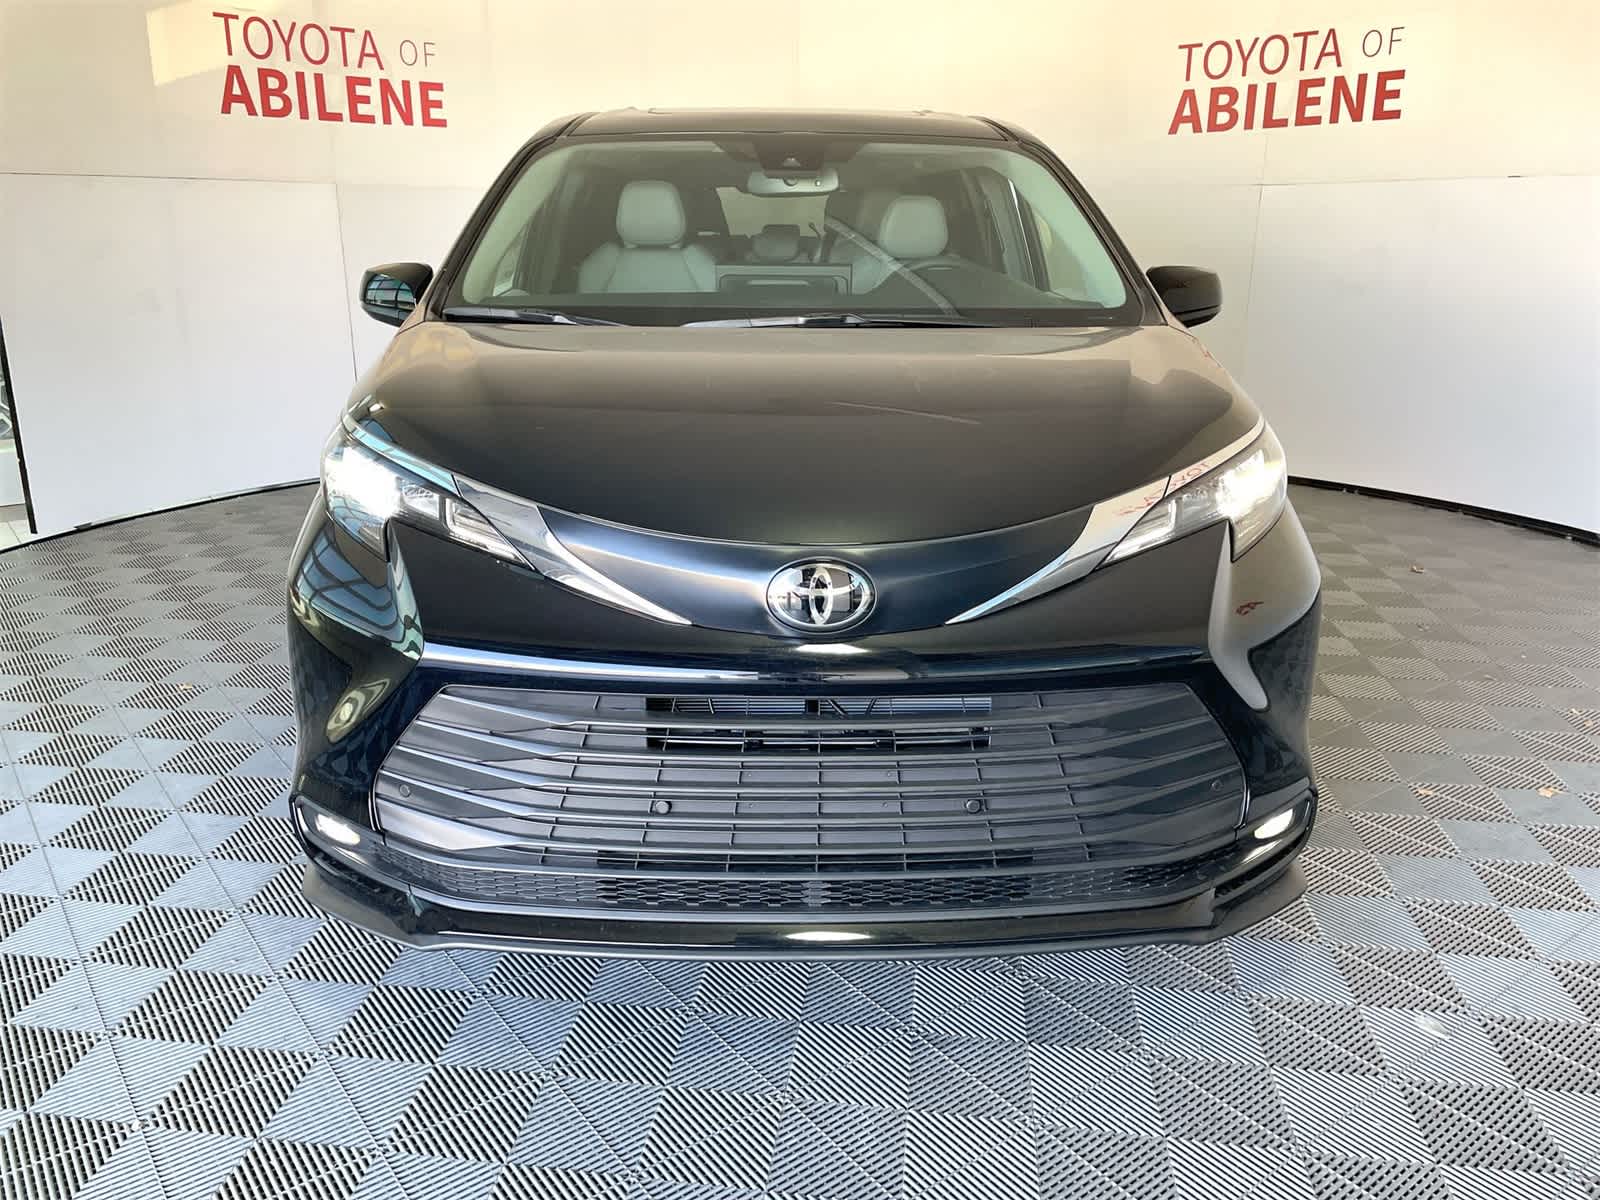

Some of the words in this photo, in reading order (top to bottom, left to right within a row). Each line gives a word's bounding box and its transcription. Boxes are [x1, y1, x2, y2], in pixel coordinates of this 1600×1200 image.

[212, 11, 384, 71] TOYOTA
[399, 40, 435, 67] OF
[1178, 28, 1343, 82] TOYOTA
[1362, 27, 1405, 57] OF
[220, 64, 448, 128] ABILENE
[1168, 69, 1406, 135] ABILENE
